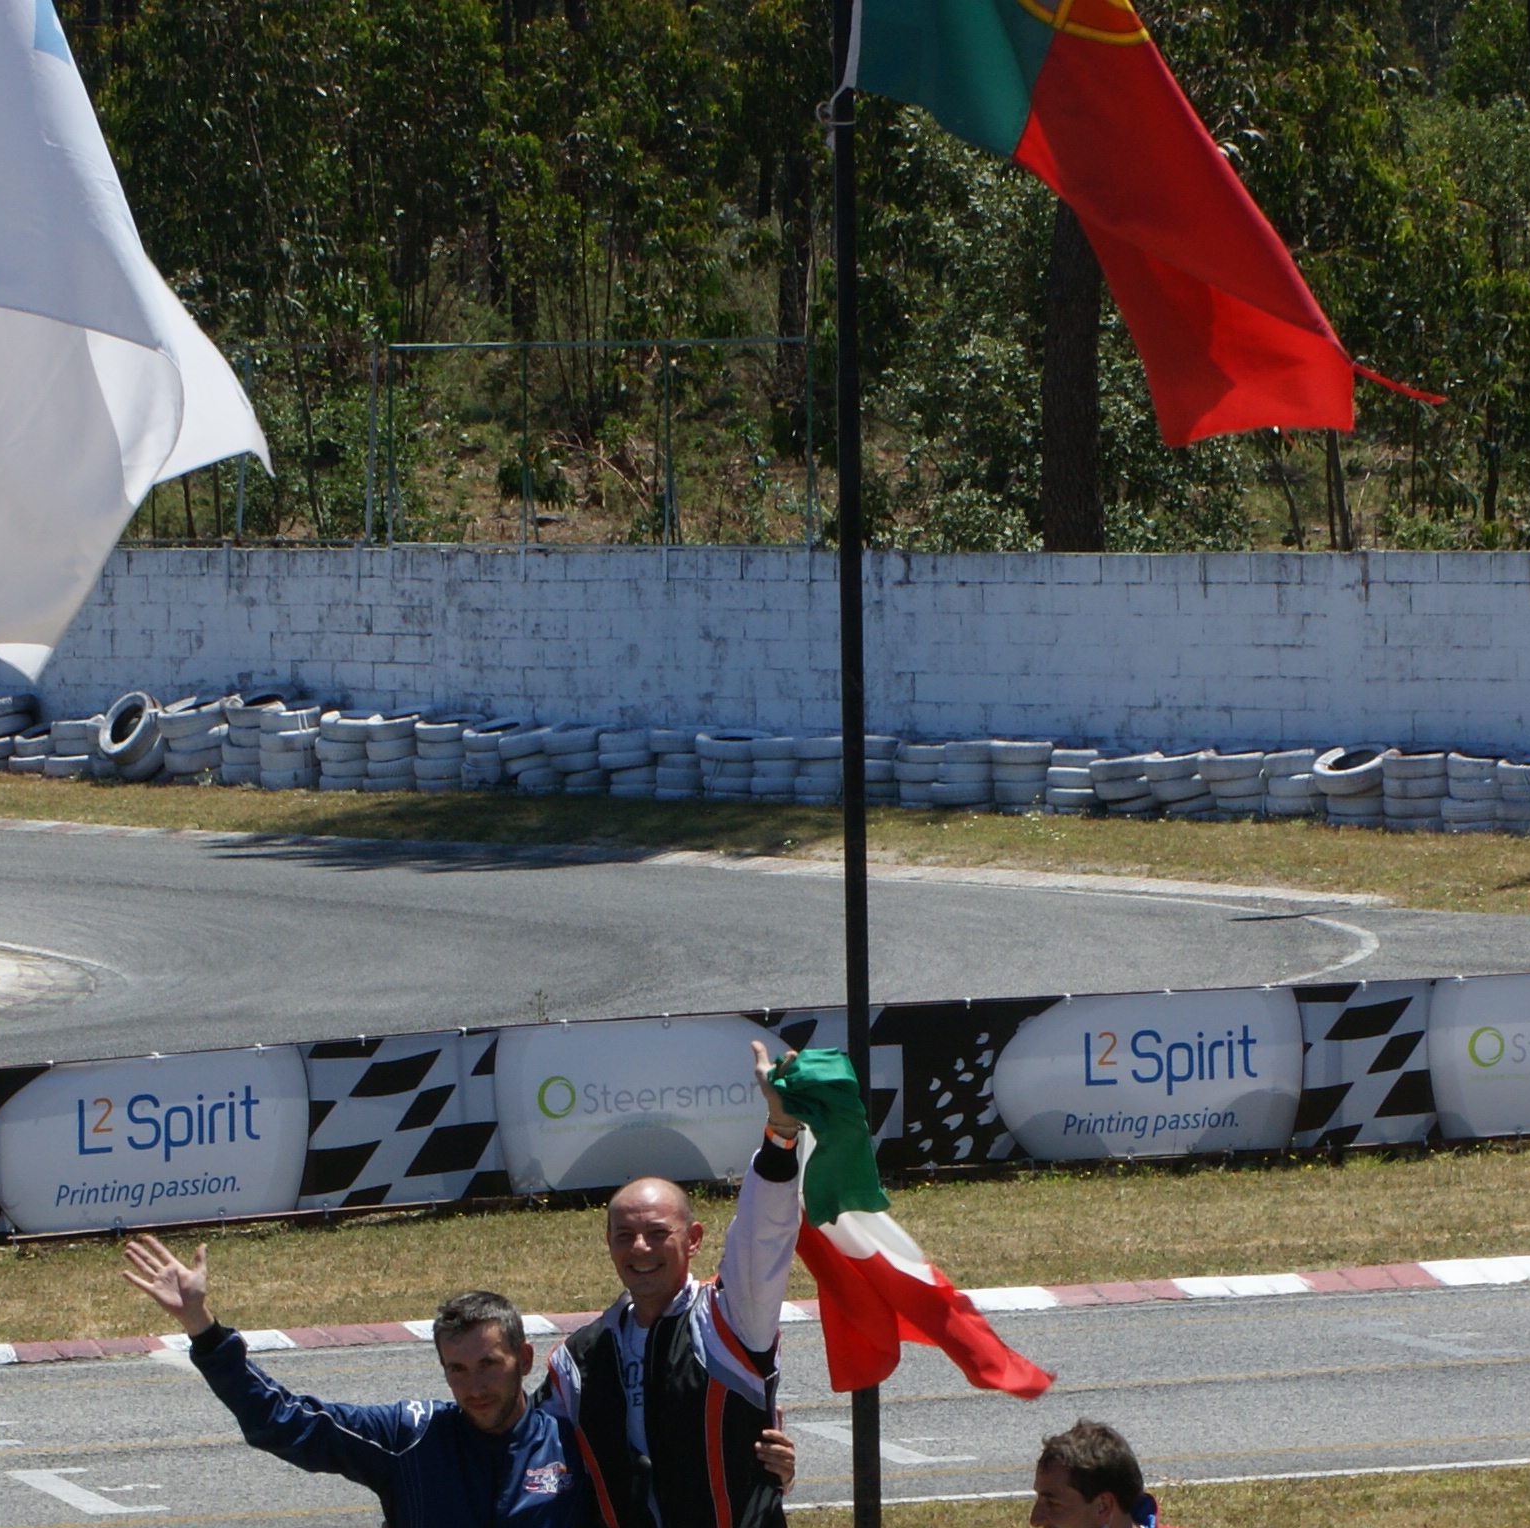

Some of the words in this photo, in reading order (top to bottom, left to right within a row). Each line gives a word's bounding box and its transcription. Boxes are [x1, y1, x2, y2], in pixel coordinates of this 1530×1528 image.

[1130, 1024, 1258, 1096] Spirit
[126, 1084, 261, 1162] Spirit
[1062, 1112, 1149, 1139] Printing
[1151, 1106, 1240, 1138] passion.
[54, 1182, 146, 1207] Printing
[148, 1171, 242, 1206] passion.
